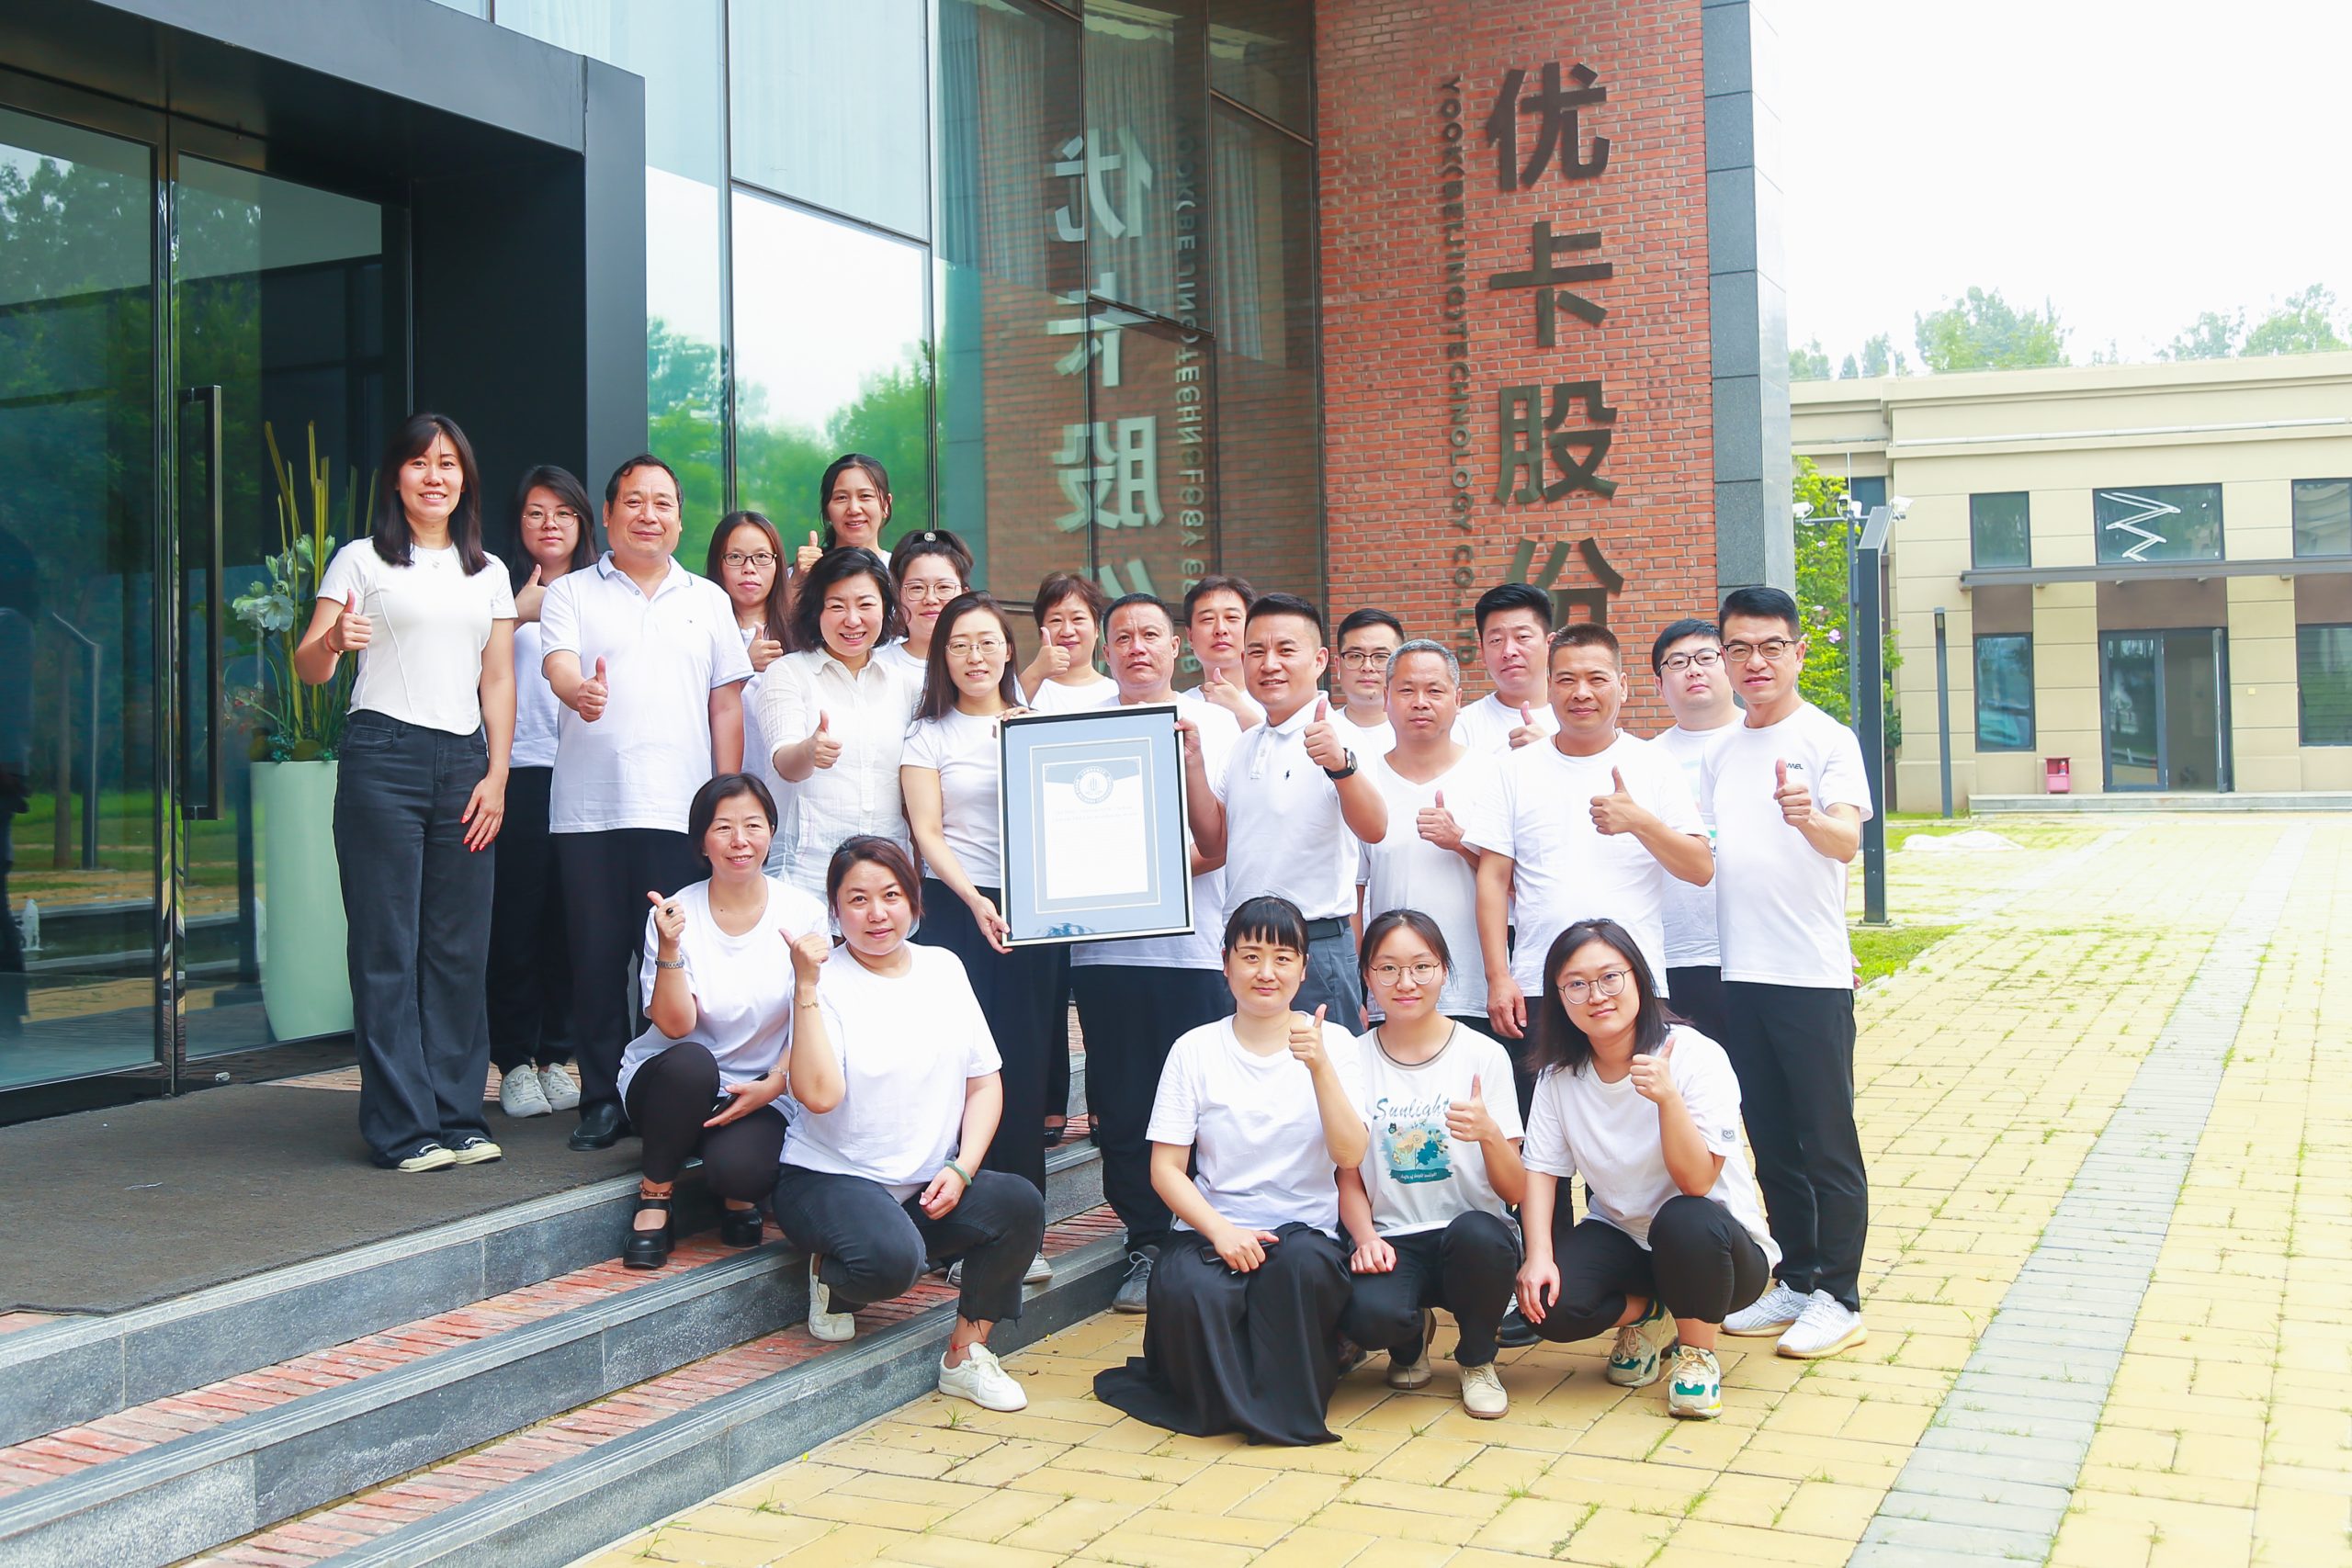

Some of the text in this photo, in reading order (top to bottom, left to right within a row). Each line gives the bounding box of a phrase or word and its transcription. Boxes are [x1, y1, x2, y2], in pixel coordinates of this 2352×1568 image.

[1486, 62, 1624, 632] 优卡股份
[1374, 1093, 1450, 1121] Sunlight
